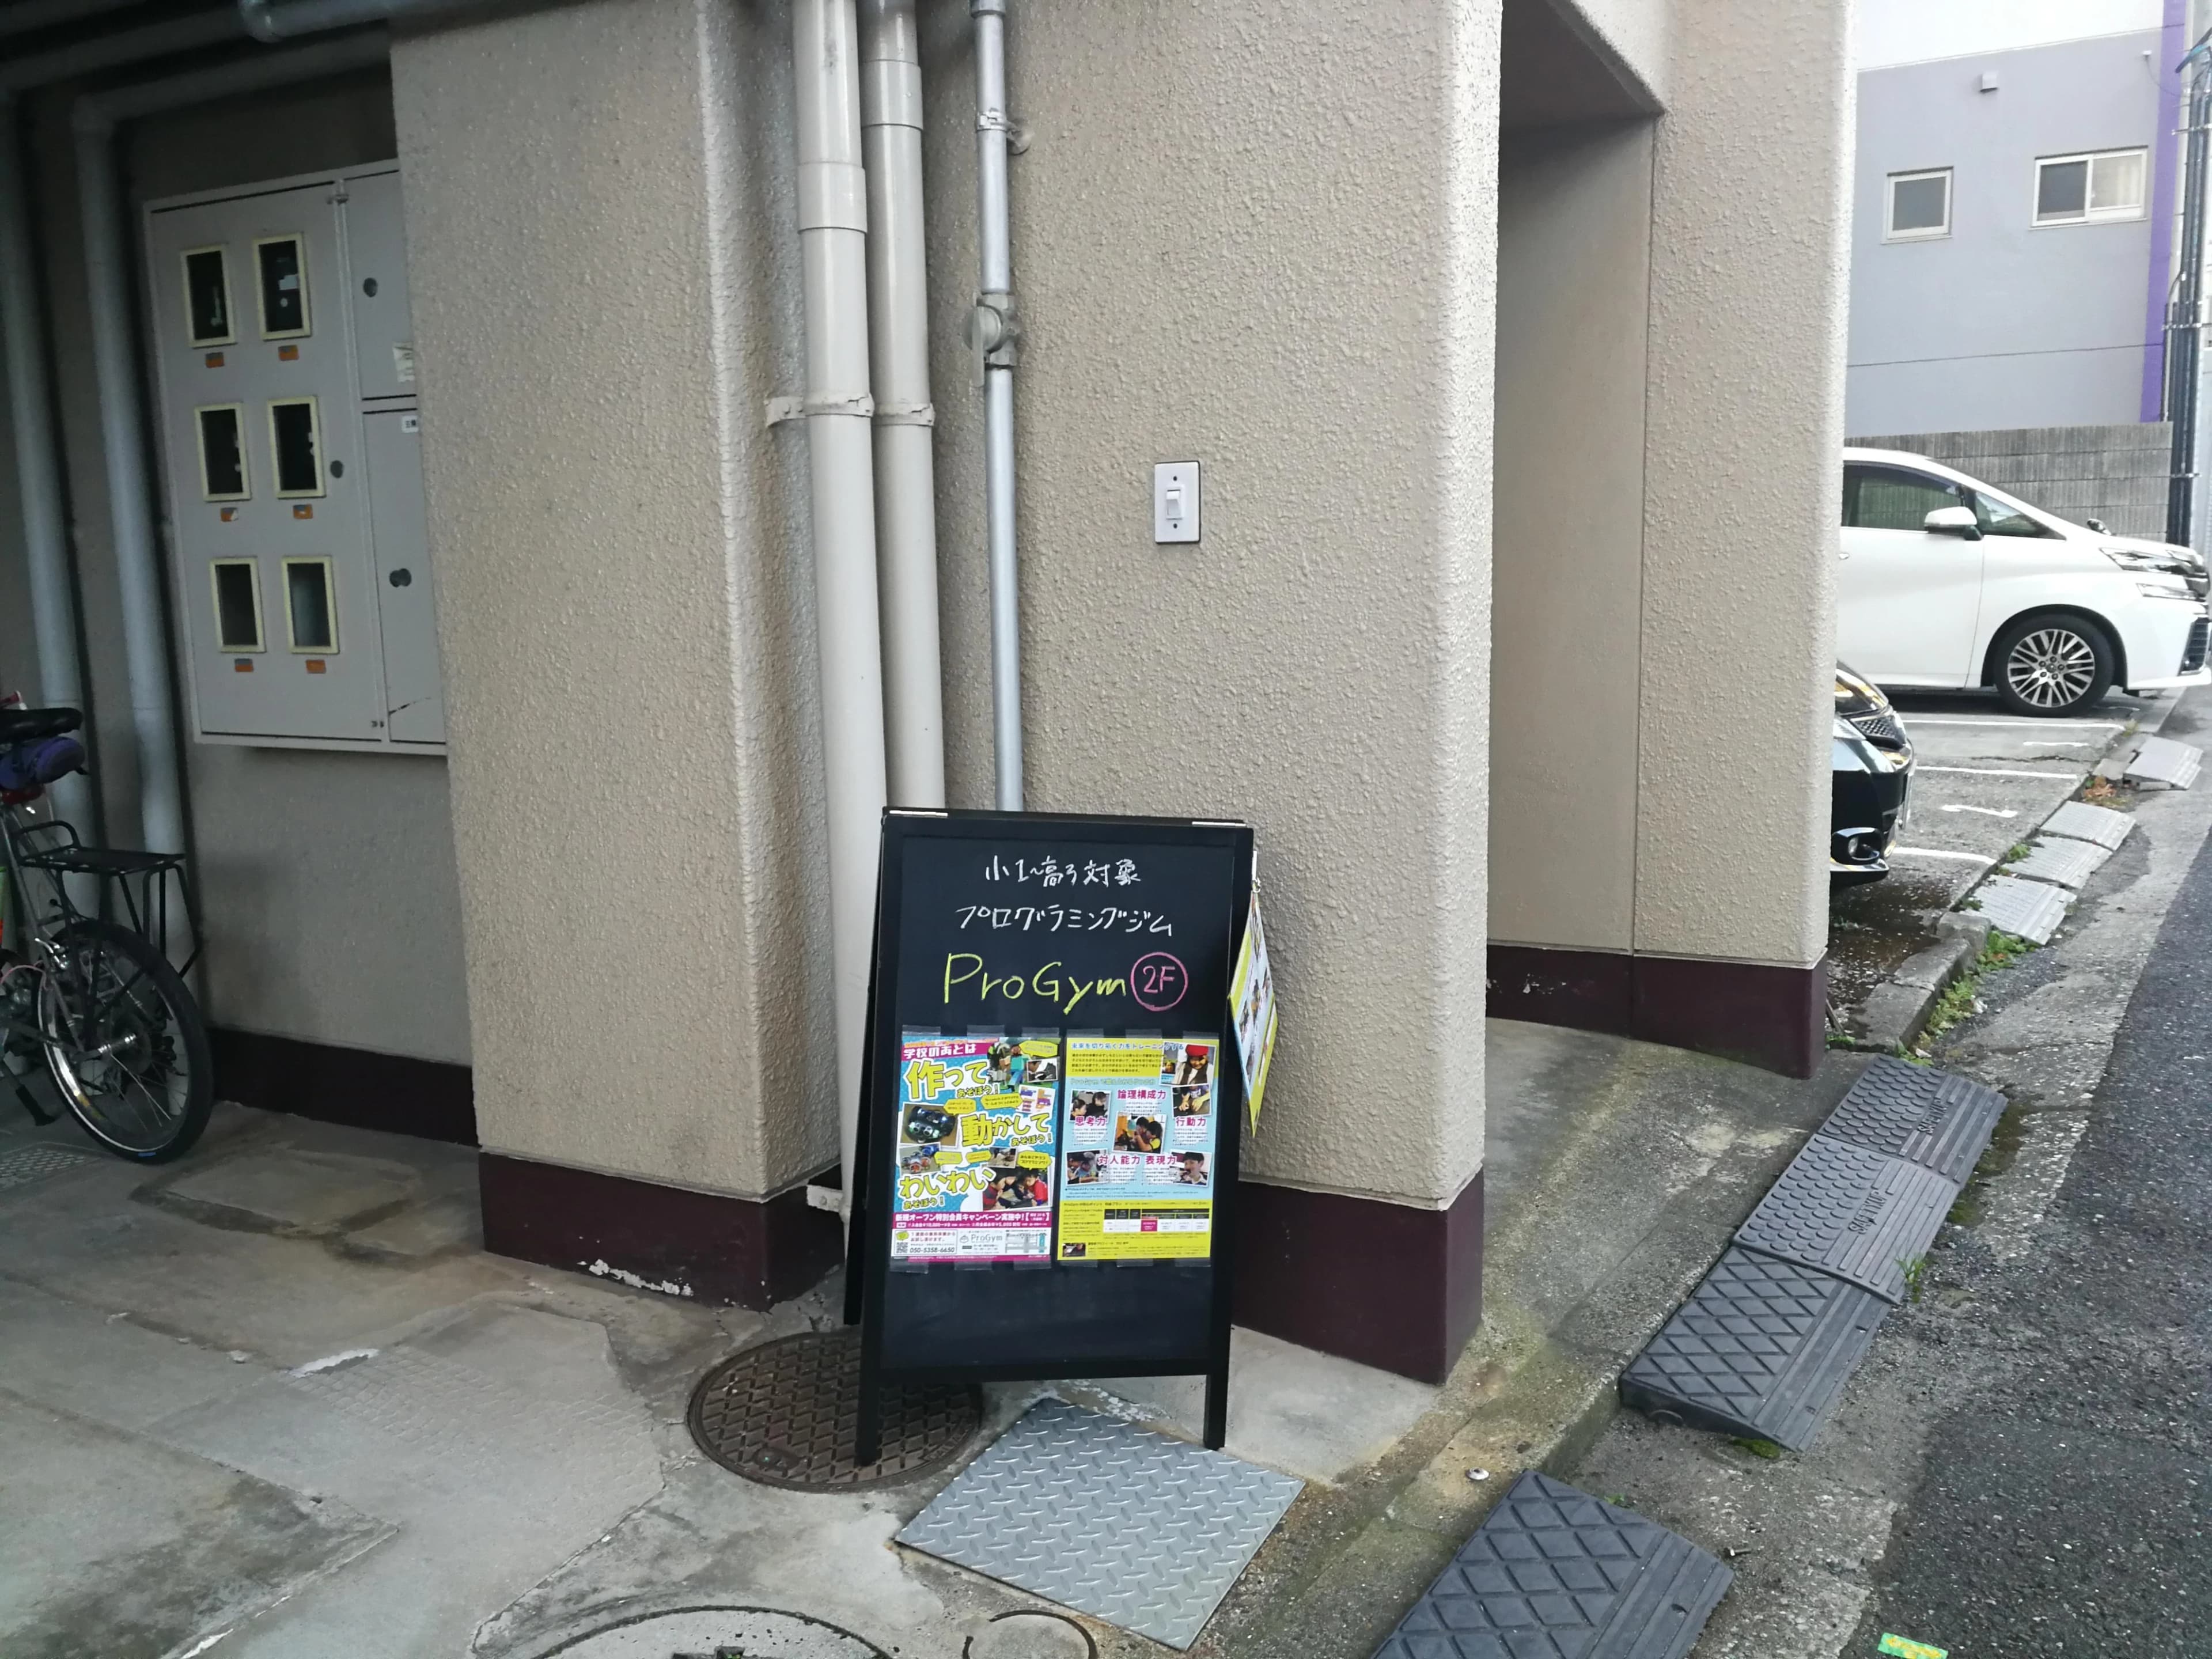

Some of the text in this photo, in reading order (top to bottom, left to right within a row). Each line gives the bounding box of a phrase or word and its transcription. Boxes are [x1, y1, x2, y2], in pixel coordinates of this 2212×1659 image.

[955, 904, 1173, 937] プログラミングジム
[944, 953, 1175, 1014] ProGym 2F
[903, 1043, 976, 1059] 学校のあとは
[906, 1060, 988, 1099] 作って
[1117, 1089, 1166, 1100] 論理構成力
[961, 1113, 1050, 1146] 動かして
[1075, 1116, 1107, 1127] 思考力
[1175, 1116, 1206, 1127] 行動力
[1098, 1155, 1177, 1165] 対人能力 表現力
[900, 1169, 995, 1199] わいわい
[971, 1234, 1003, 1243] ProGym
